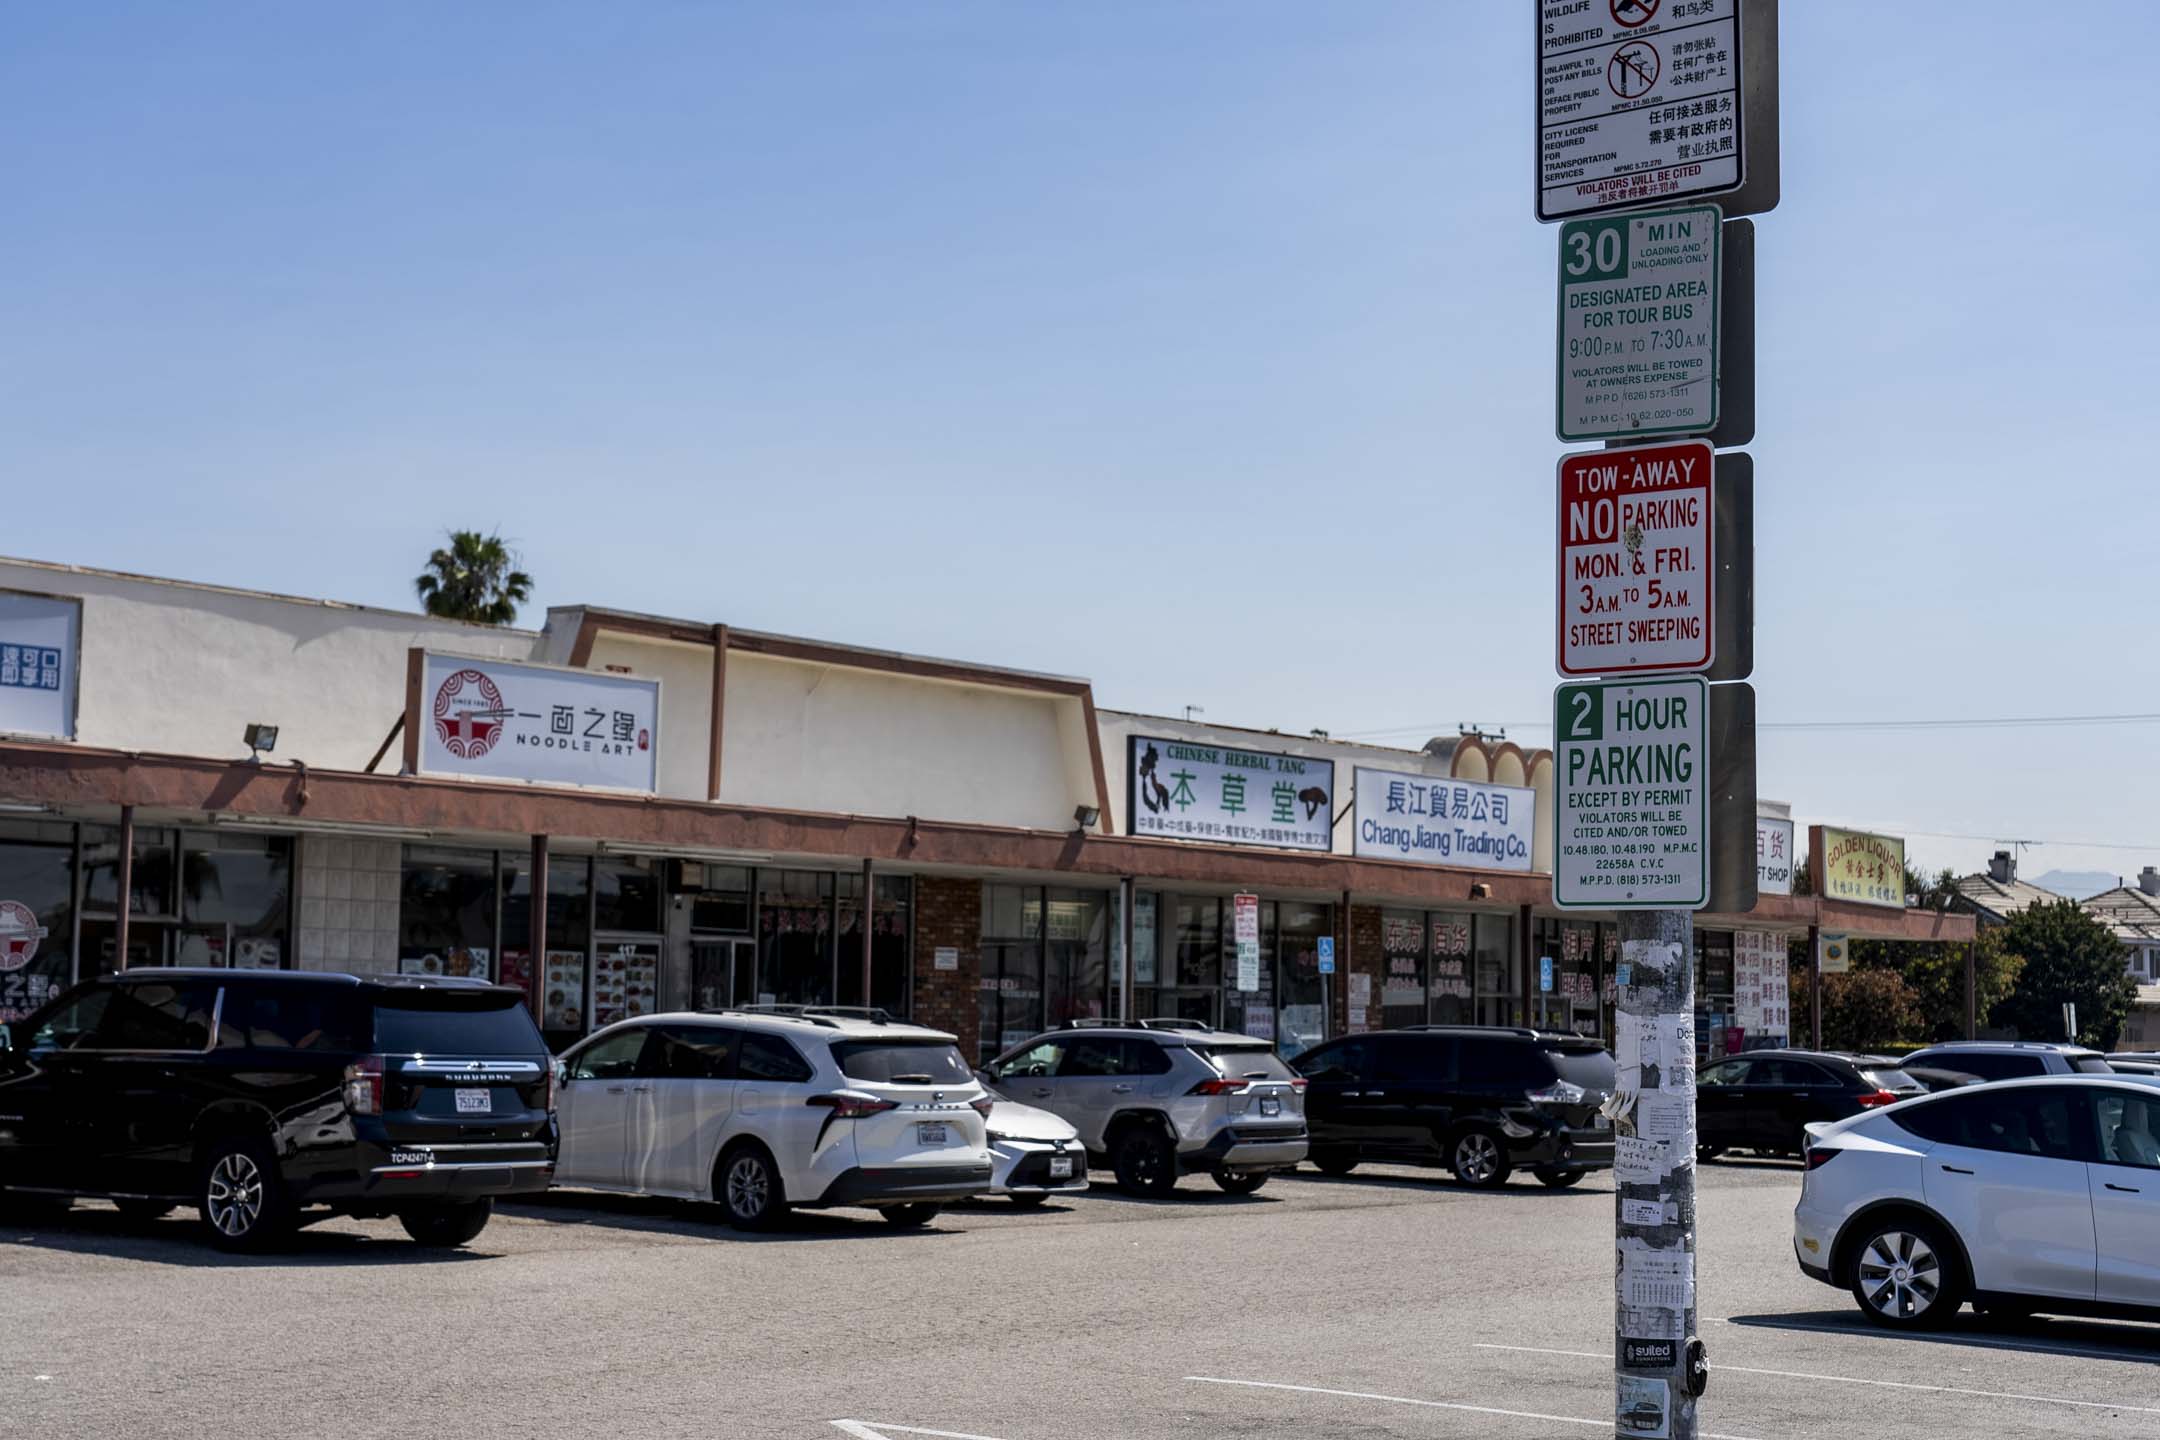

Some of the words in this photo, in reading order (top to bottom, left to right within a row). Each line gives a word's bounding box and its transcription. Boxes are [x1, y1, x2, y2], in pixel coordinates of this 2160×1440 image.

[1545, 1, 1590, 19] WILDLIFE
[1544, 24, 1554, 34] IS
[1545, 28, 1603, 49] PROHIBITED
[1672, 36, 1716, 56] 请勿张贴
[1544, 61, 1582, 75] UNLAWFUL
[1585, 58, 1594, 66] TO
[1672, 50, 1727, 71] 任何广告在
[1544, 76, 1563, 85] POST
[1565, 71, 1580, 82] ANY
[1582, 67, 1602, 78] BILLS
[1672, 66, 1727, 85] 公共财产上
[1544, 87, 1555, 96] OR
[1544, 94, 1572, 106] DEFACE
[1573, 88, 1600, 100] PUBLIC
[1544, 103, 1582, 116] PROPERTY
[1649, 98, 1732, 125] 任何接送服务
[1544, 131, 1563, 140] CITY
[1565, 124, 1599, 137] LICENSE
[1649, 117, 1732, 144] 需要有政府的
[1544, 137, 1585, 151] REQUIRED
[1678, 136, 1733, 160] 营业执照
[1544, 152, 1560, 161] FOR
[1544, 152, 1617, 171] TRANSPORTATION
[1544, 168, 1584, 182] SERVICES
[1576, 178, 1629, 196] VIOLATORS
[1631, 174, 1655, 186] WILL
[1658, 170, 1671, 181] BE
[1673, 165, 1701, 179] CITED
[1566, 227, 1621, 276] 30
[1649, 221, 1691, 241] MIN
[1641, 246, 1679, 258] LOADING
[1682, 243, 1700, 254] AND
[1632, 256, 1683, 270] UNLOADING
[1686, 254, 1709, 265] ONLY
[1570, 285, 1662, 308] DESIGNATED
[1666, 280, 1708, 298] AREA
[1584, 312, 1614, 328] FOR
[1617, 308, 1658, 326] TOUR
[1663, 304, 1693, 321] BUS
[1632, 340, 1645, 352] TO
[1572, 365, 1624, 378] VIOLATORS
[1627, 364, 1649, 373] WILL
[1652, 362, 1665, 370] BE
[1668, 359, 1703, 369] TOWED
[1586, 380, 1597, 388] AT
[1600, 376, 1641, 386] OWNERS
[1644, 371, 1688, 383] EXPENSE
[1624, 391, 1647, 400] (626)
[1649, 388, 1688, 399] 573-1311
[1570, 498, 1615, 542] NO
[1624, 497, 1697, 532] PARKING
[1575, 553, 1624, 580] MON.
[1633, 548, 1646, 576] &
[1655, 547, 1696, 573] FRI.
[1624, 588, 1639, 603] TO
[1571, 622, 1623, 647] STREET
[1628, 617, 1700, 643] SWEEPING
[1571, 691, 1592, 736] 2
[1617, 697, 1687, 731] HOUR
[517, 734, 591, 752] NOODLE
[601, 744, 634, 756] ART
[1166, 745, 1219, 764] CHINESE
[1225, 754, 1271, 770] HERBAL
[1276, 759, 1305, 775] TANG
[1569, 743, 1692, 786] PARKING
[1170, 768, 1297, 824] 本草堂
[1386, 781, 1508, 825] 長江貿易公司
[1569, 792, 1617, 808] EXCEPT
[1622, 791, 1640, 806] BY
[1645, 789, 1692, 806] PERMIT
[1579, 812, 1637, 824] VIOLATORS
[1641, 811, 1664, 822] WILL
[1668, 810, 1682, 821] BE
[1362, 819, 1410, 852] Chang
[1412, 824, 1449, 856] Jiang
[1454, 828, 1505, 861] Trading
[1507, 834, 1527, 857] Co.
[1574, 827, 1603, 838] CITED
[1607, 826, 1648, 838] AND/OR
[1652, 825, 1687, 836] TOWED
[1612, 844, 1655, 854] 10.48.190
[1828, 835, 1864, 868] GOLDEN
[1867, 838, 1901, 880] LIQUOR
[1596, 860, 1634, 869] 22658A
[1617, 875, 1639, 885] (818)
[1642, 874, 1681, 884] 573-1311
[1768, 867, 1788, 882] SHOP
[1636, 1345, 1670, 1356] suited
